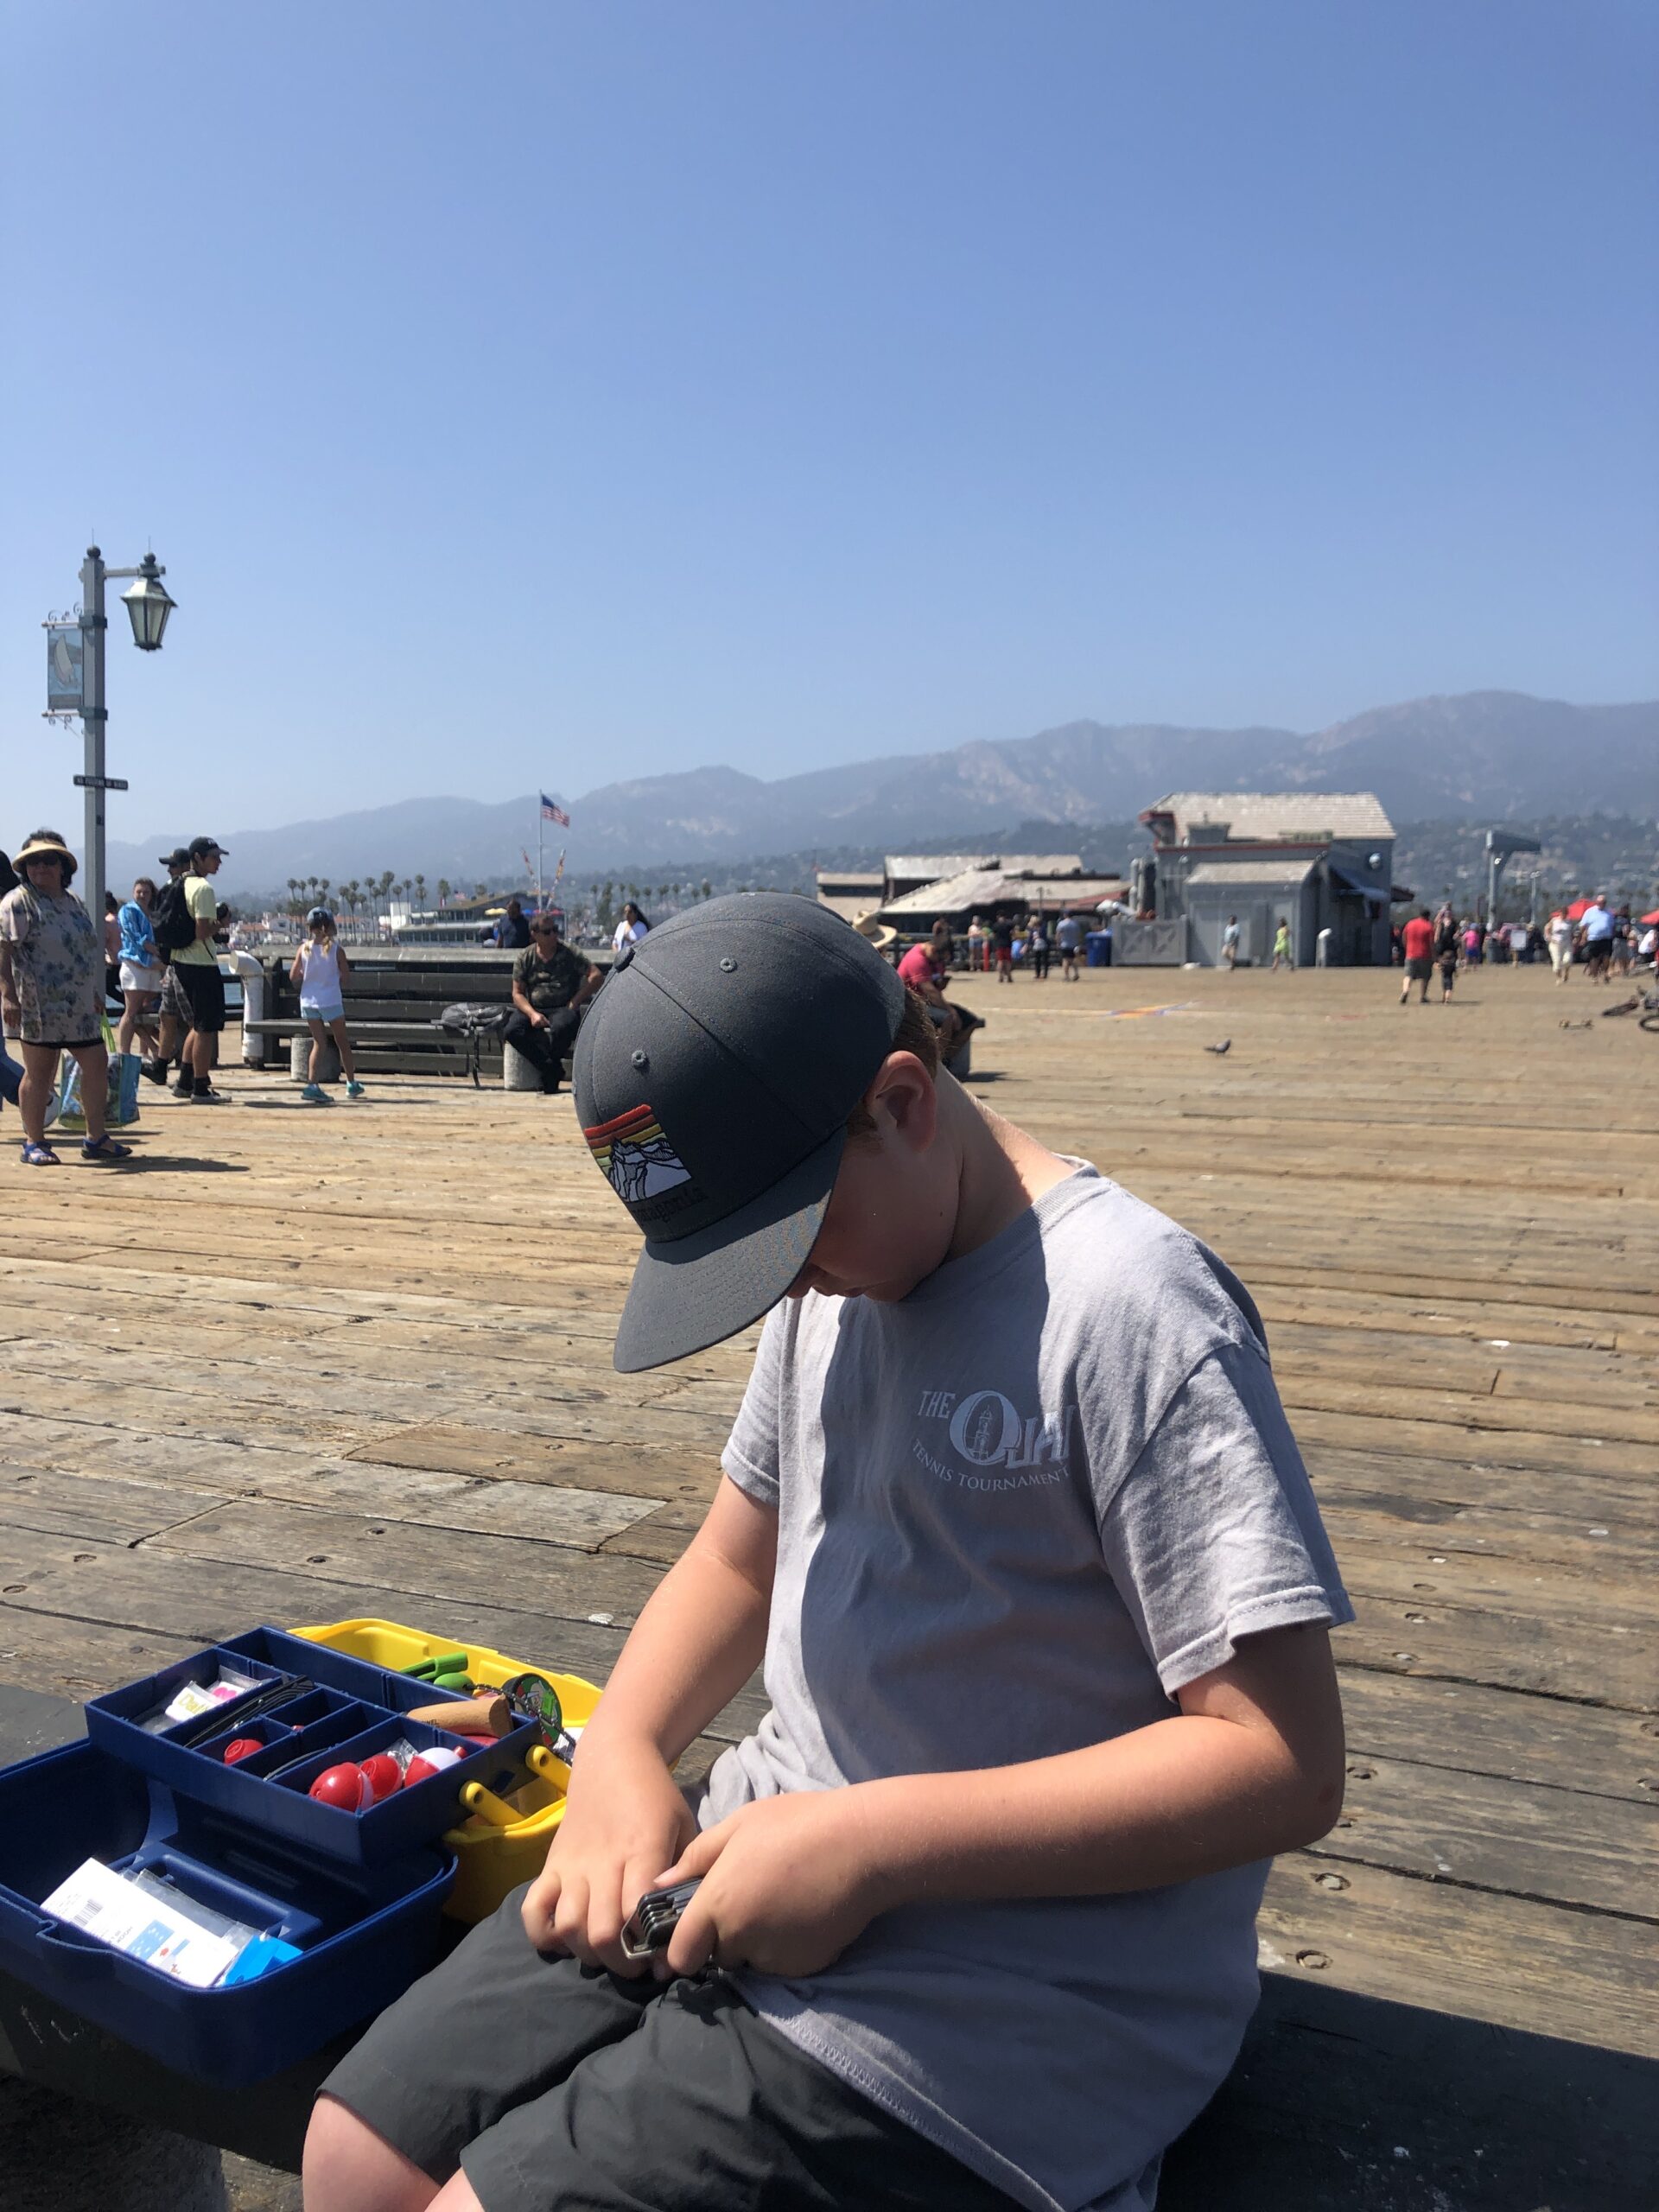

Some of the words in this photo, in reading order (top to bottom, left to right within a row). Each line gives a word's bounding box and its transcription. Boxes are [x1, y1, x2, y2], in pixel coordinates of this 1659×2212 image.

[918, 1390, 956, 1419] THE
[912, 1438, 954, 1481] TENNIS
[958, 1466, 1070, 1491] TOURNAMENT
